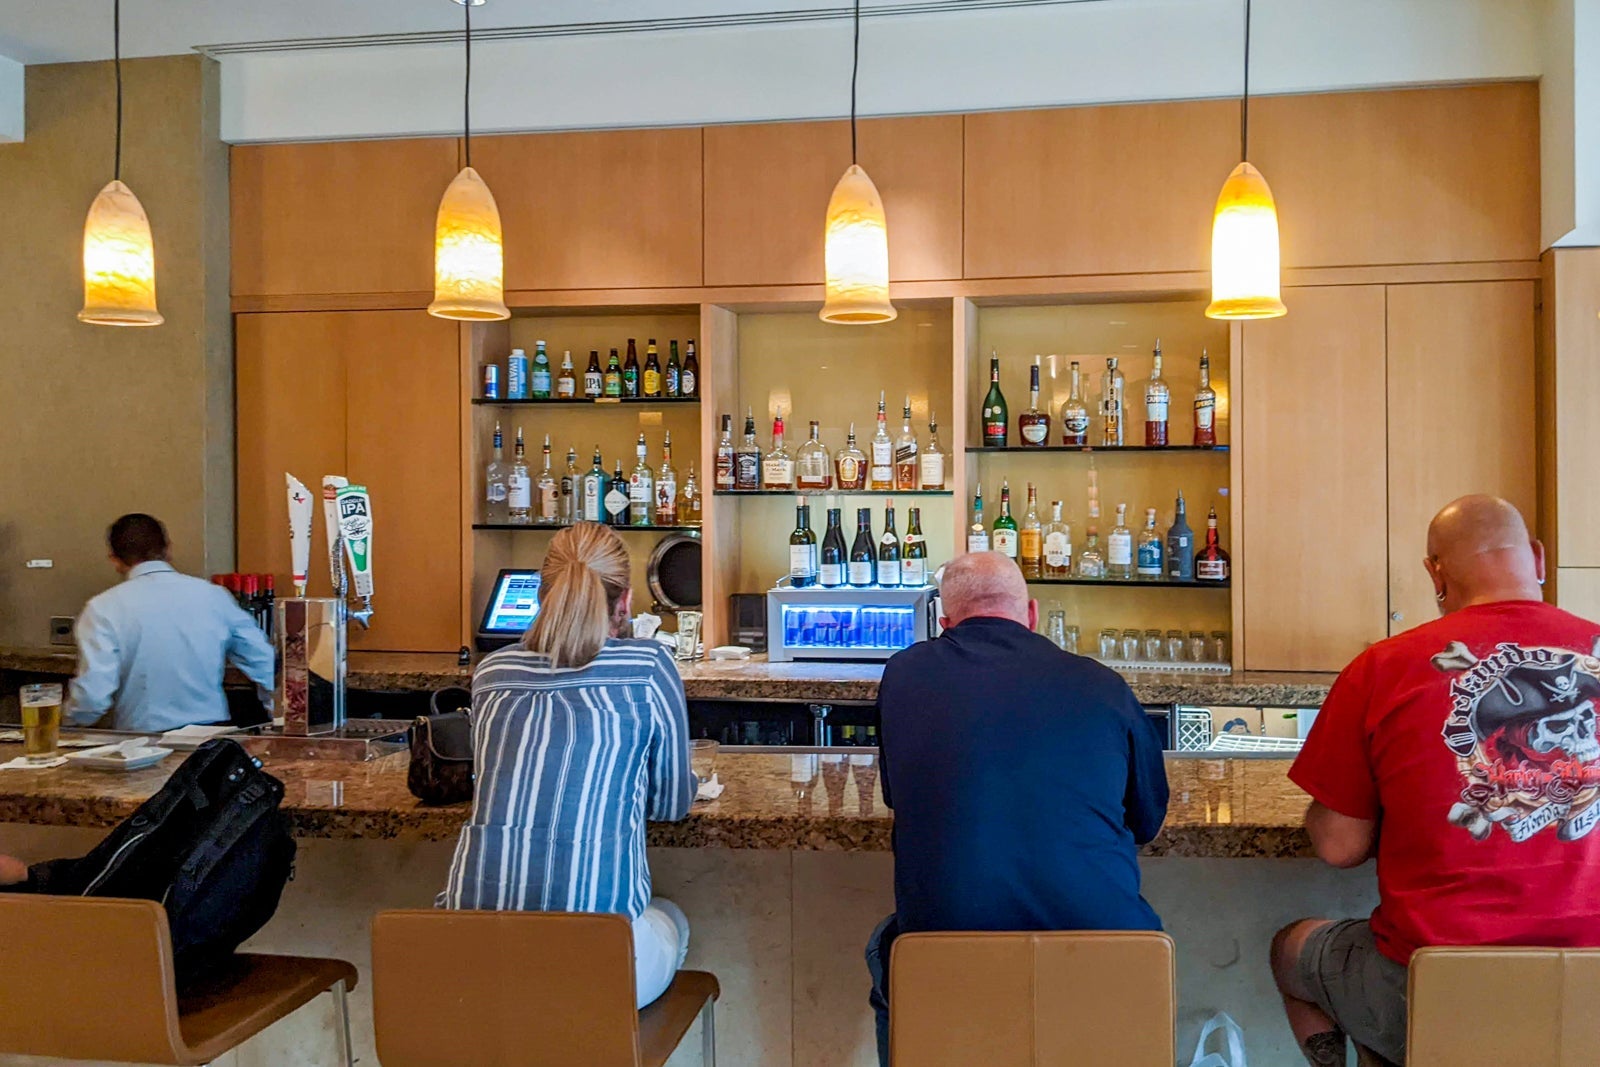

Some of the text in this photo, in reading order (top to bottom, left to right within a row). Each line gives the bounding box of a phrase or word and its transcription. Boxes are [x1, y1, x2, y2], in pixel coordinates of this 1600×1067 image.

[585, 378, 601, 389] IPA
[342, 502, 365, 515] IPA
[1519, 802, 1561, 840] Florida
